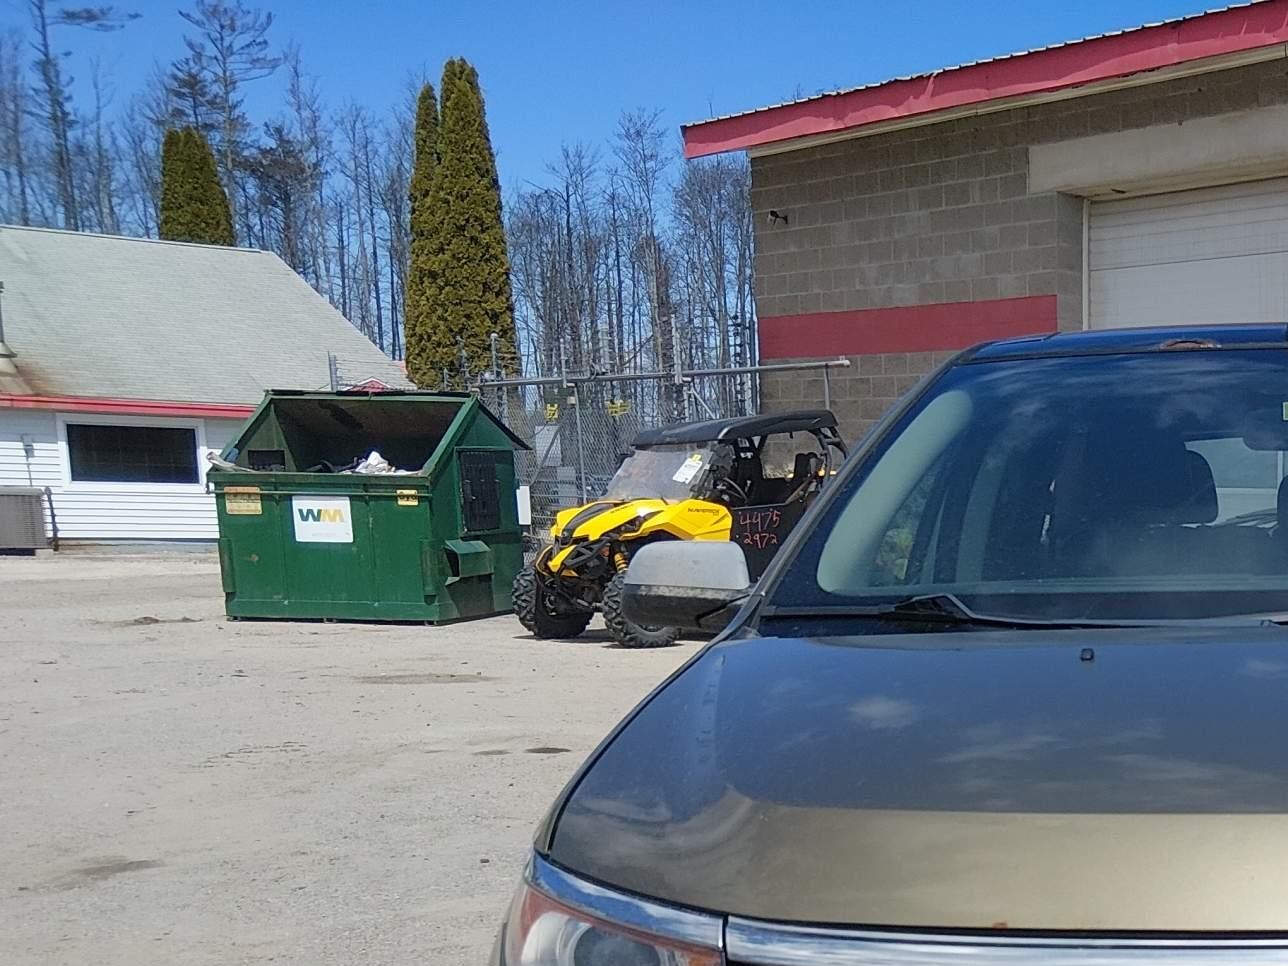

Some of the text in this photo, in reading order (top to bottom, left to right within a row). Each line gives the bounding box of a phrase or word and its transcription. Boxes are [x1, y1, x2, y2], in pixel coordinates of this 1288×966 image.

[297, 508, 345, 523] WM
[739, 509, 782, 532] 4475
[743, 532, 778, 549] 2972
